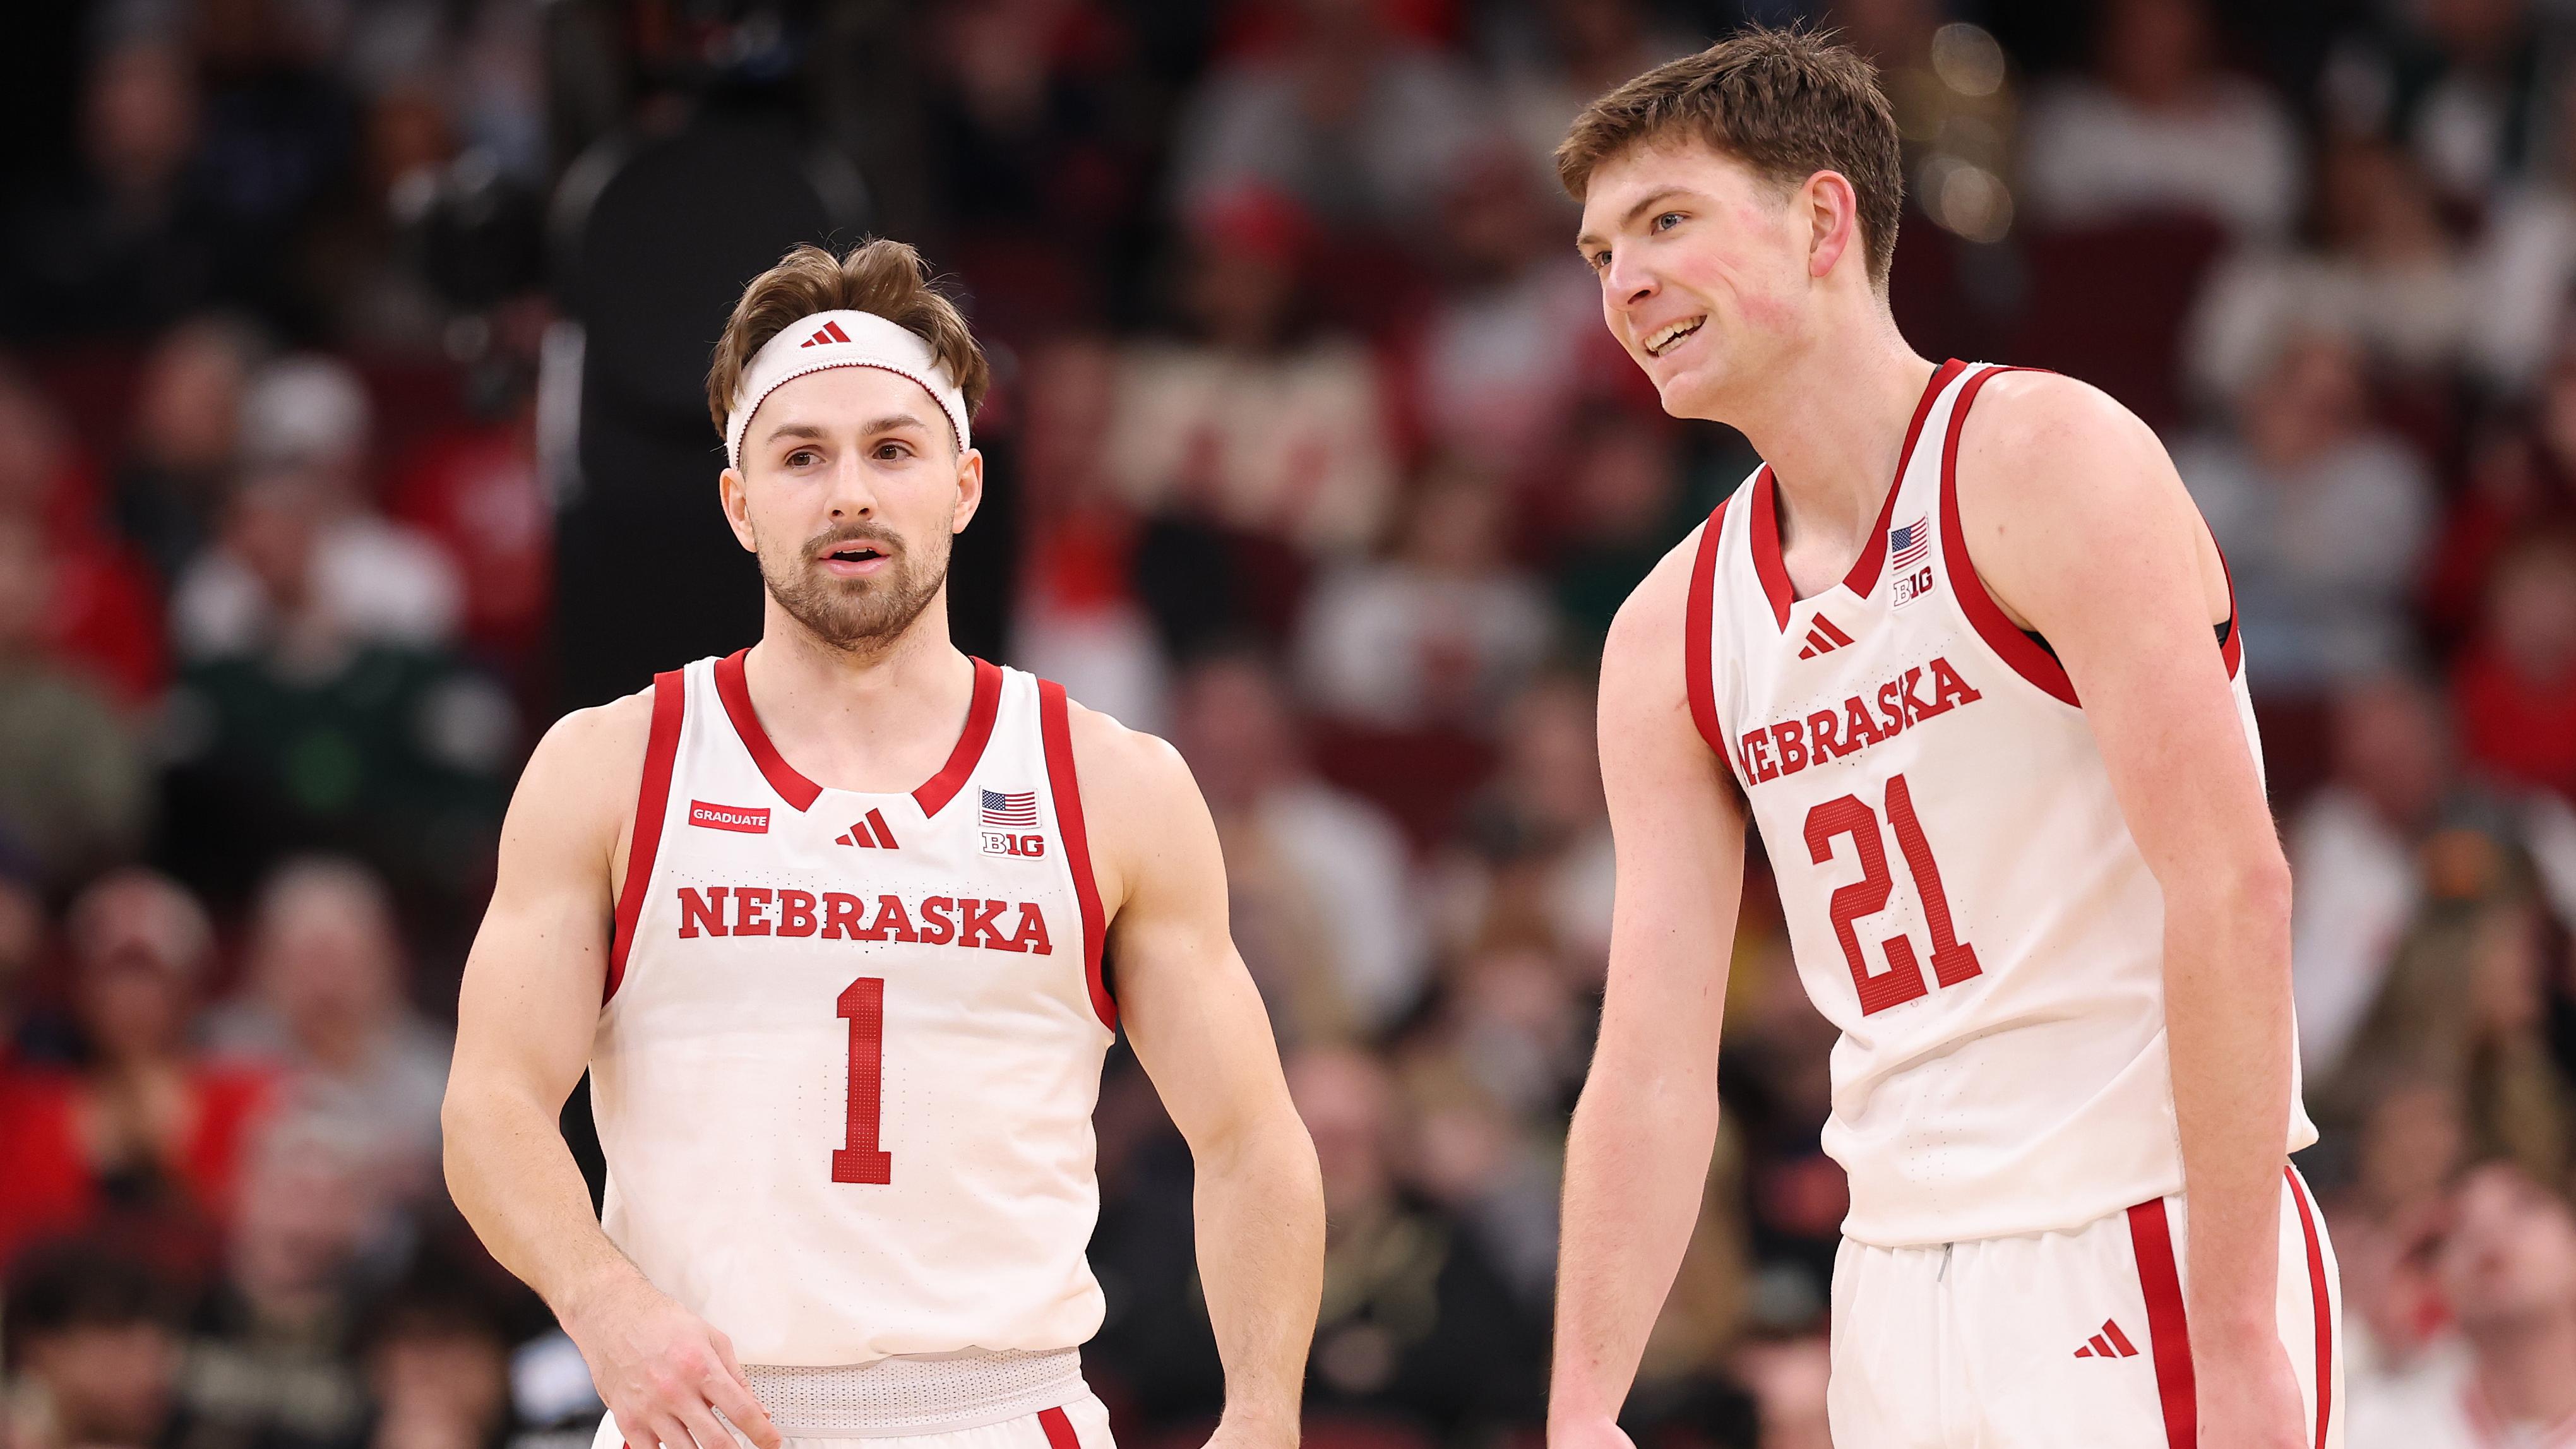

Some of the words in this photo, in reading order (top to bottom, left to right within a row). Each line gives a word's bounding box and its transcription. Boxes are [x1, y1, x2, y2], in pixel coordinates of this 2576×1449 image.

[693, 809, 767, 826] GRADUATE
[678, 886, 1053, 955] NEBRASKA
[1804, 773, 1983, 1017] 21
[832, 977, 891, 1184] 1
